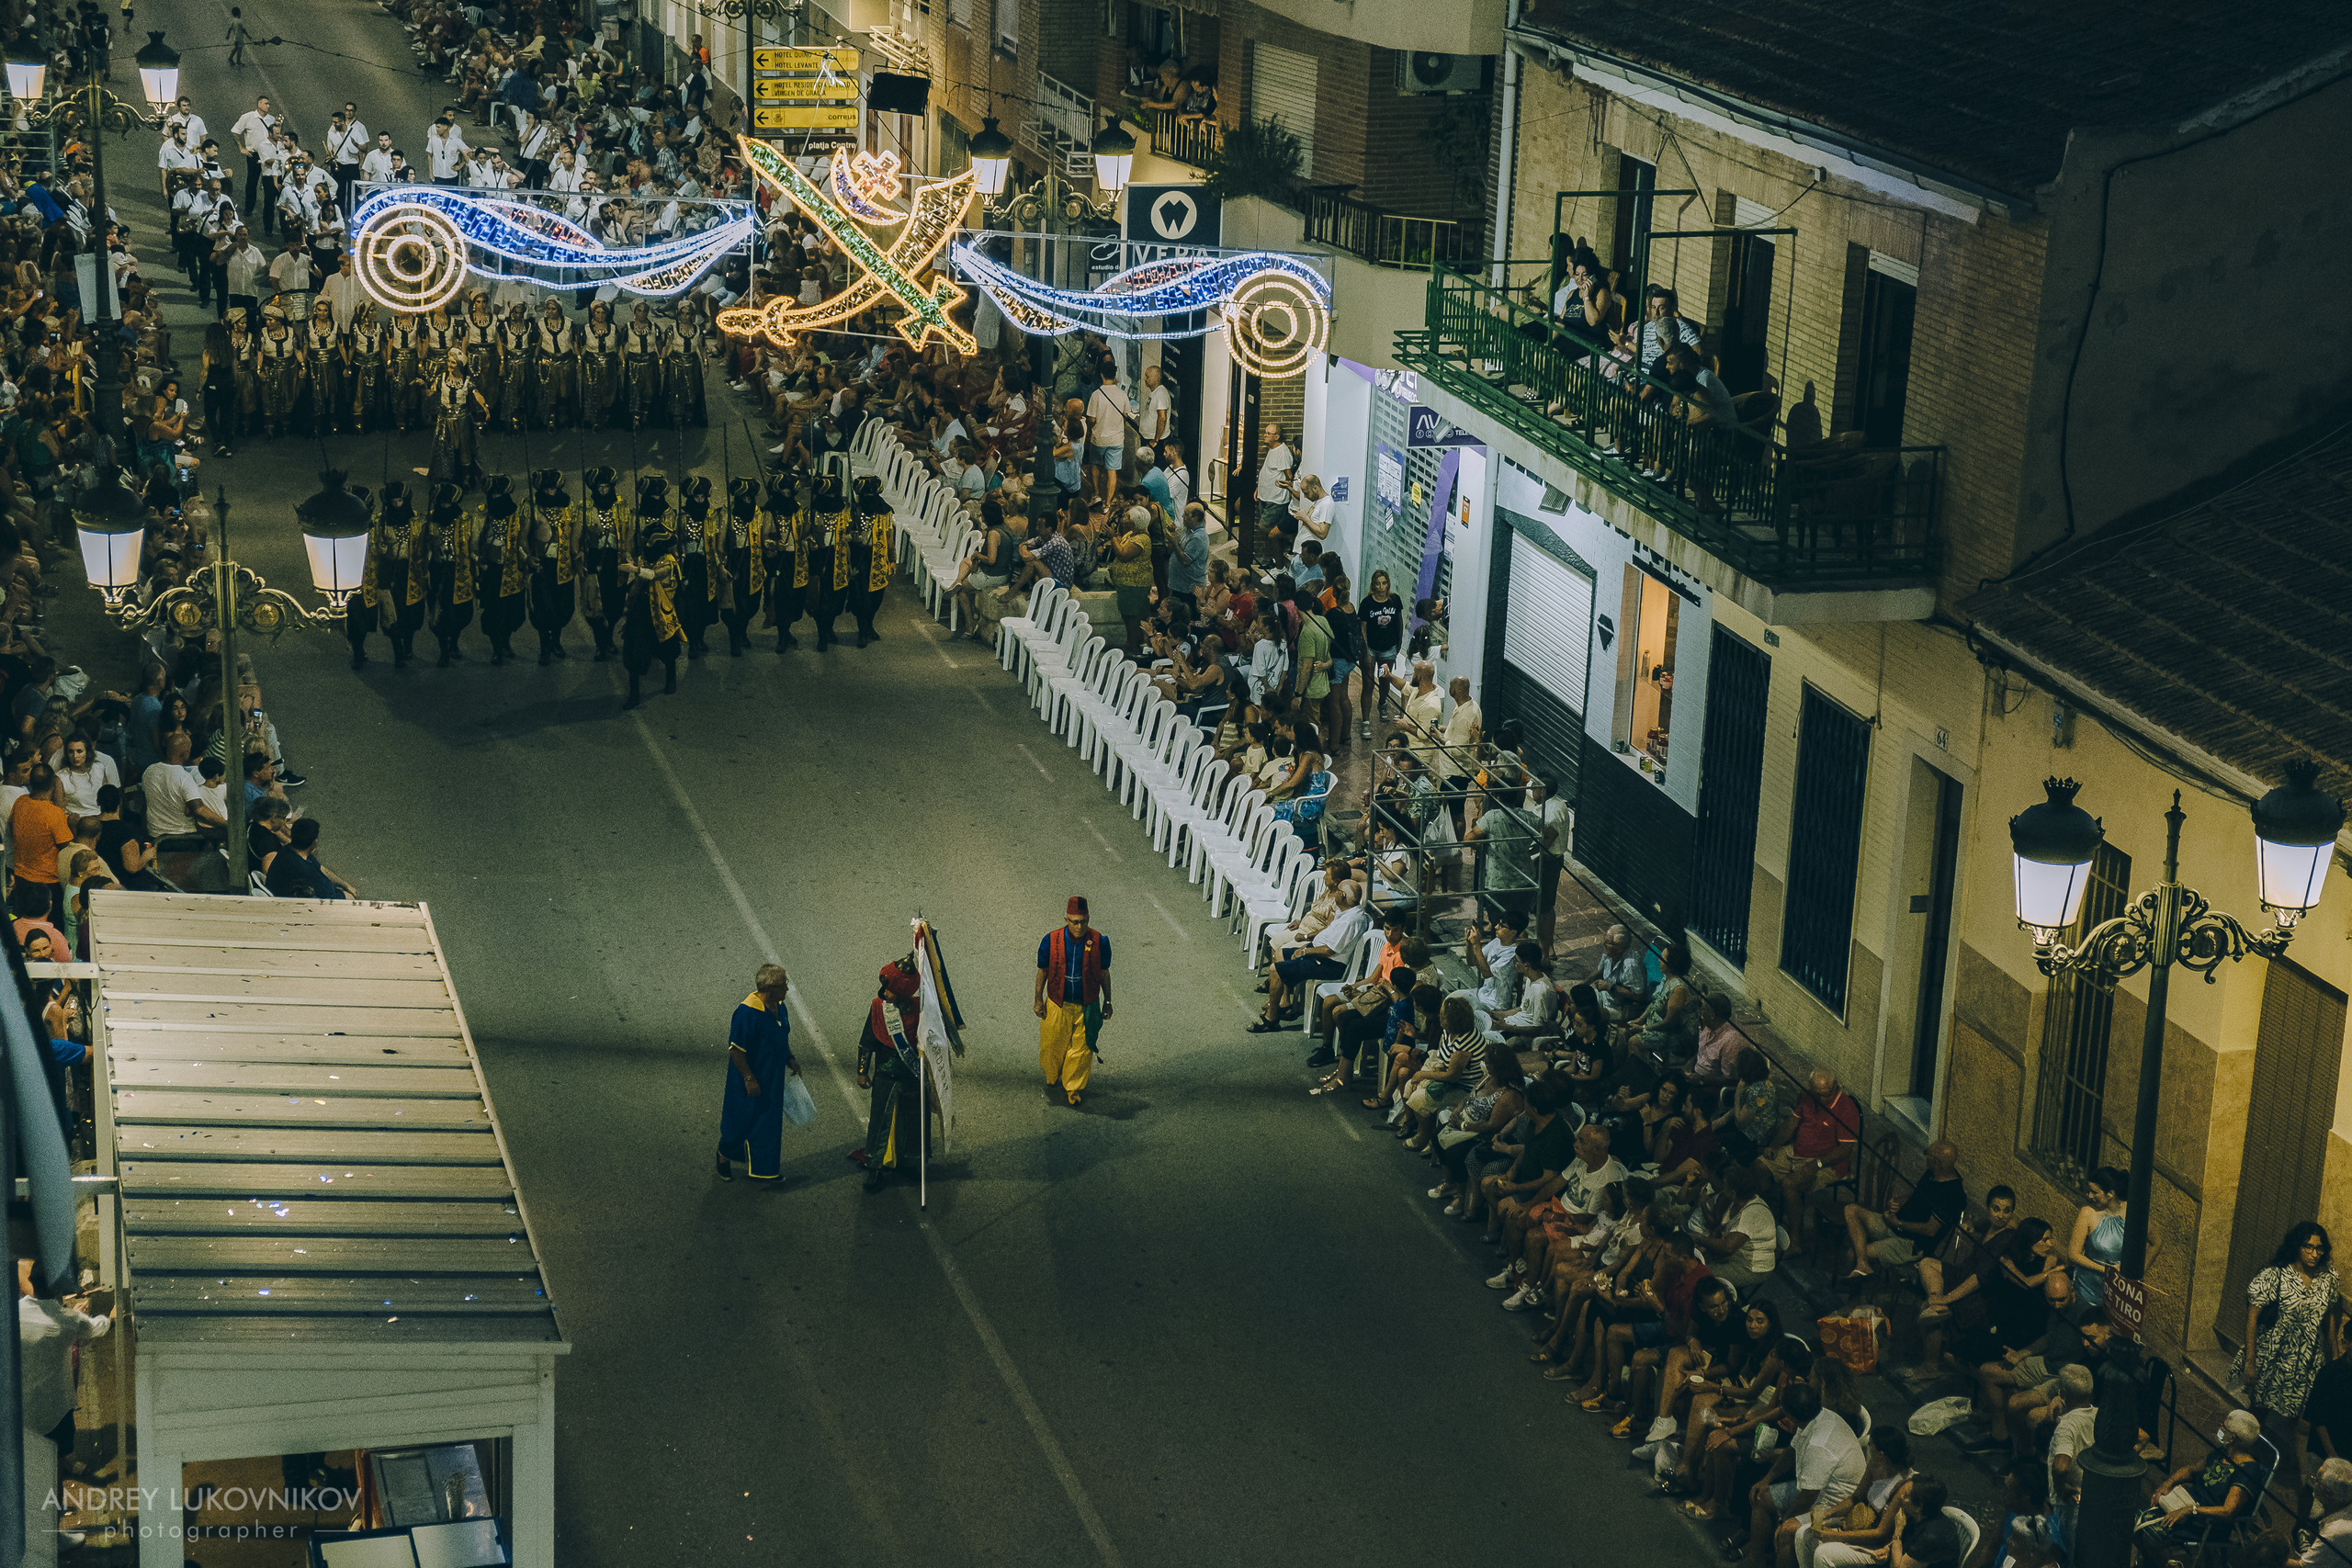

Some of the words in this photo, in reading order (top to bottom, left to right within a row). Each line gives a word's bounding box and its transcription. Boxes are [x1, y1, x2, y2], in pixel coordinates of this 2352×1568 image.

[808, 141, 830, 152] platja
[1937, 730, 1946, 748] 64
[2112, 1272, 2143, 1305] ZONA
[2104, 1281, 2113, 1302] DE
[2115, 1294, 2142, 1323] TIRO
